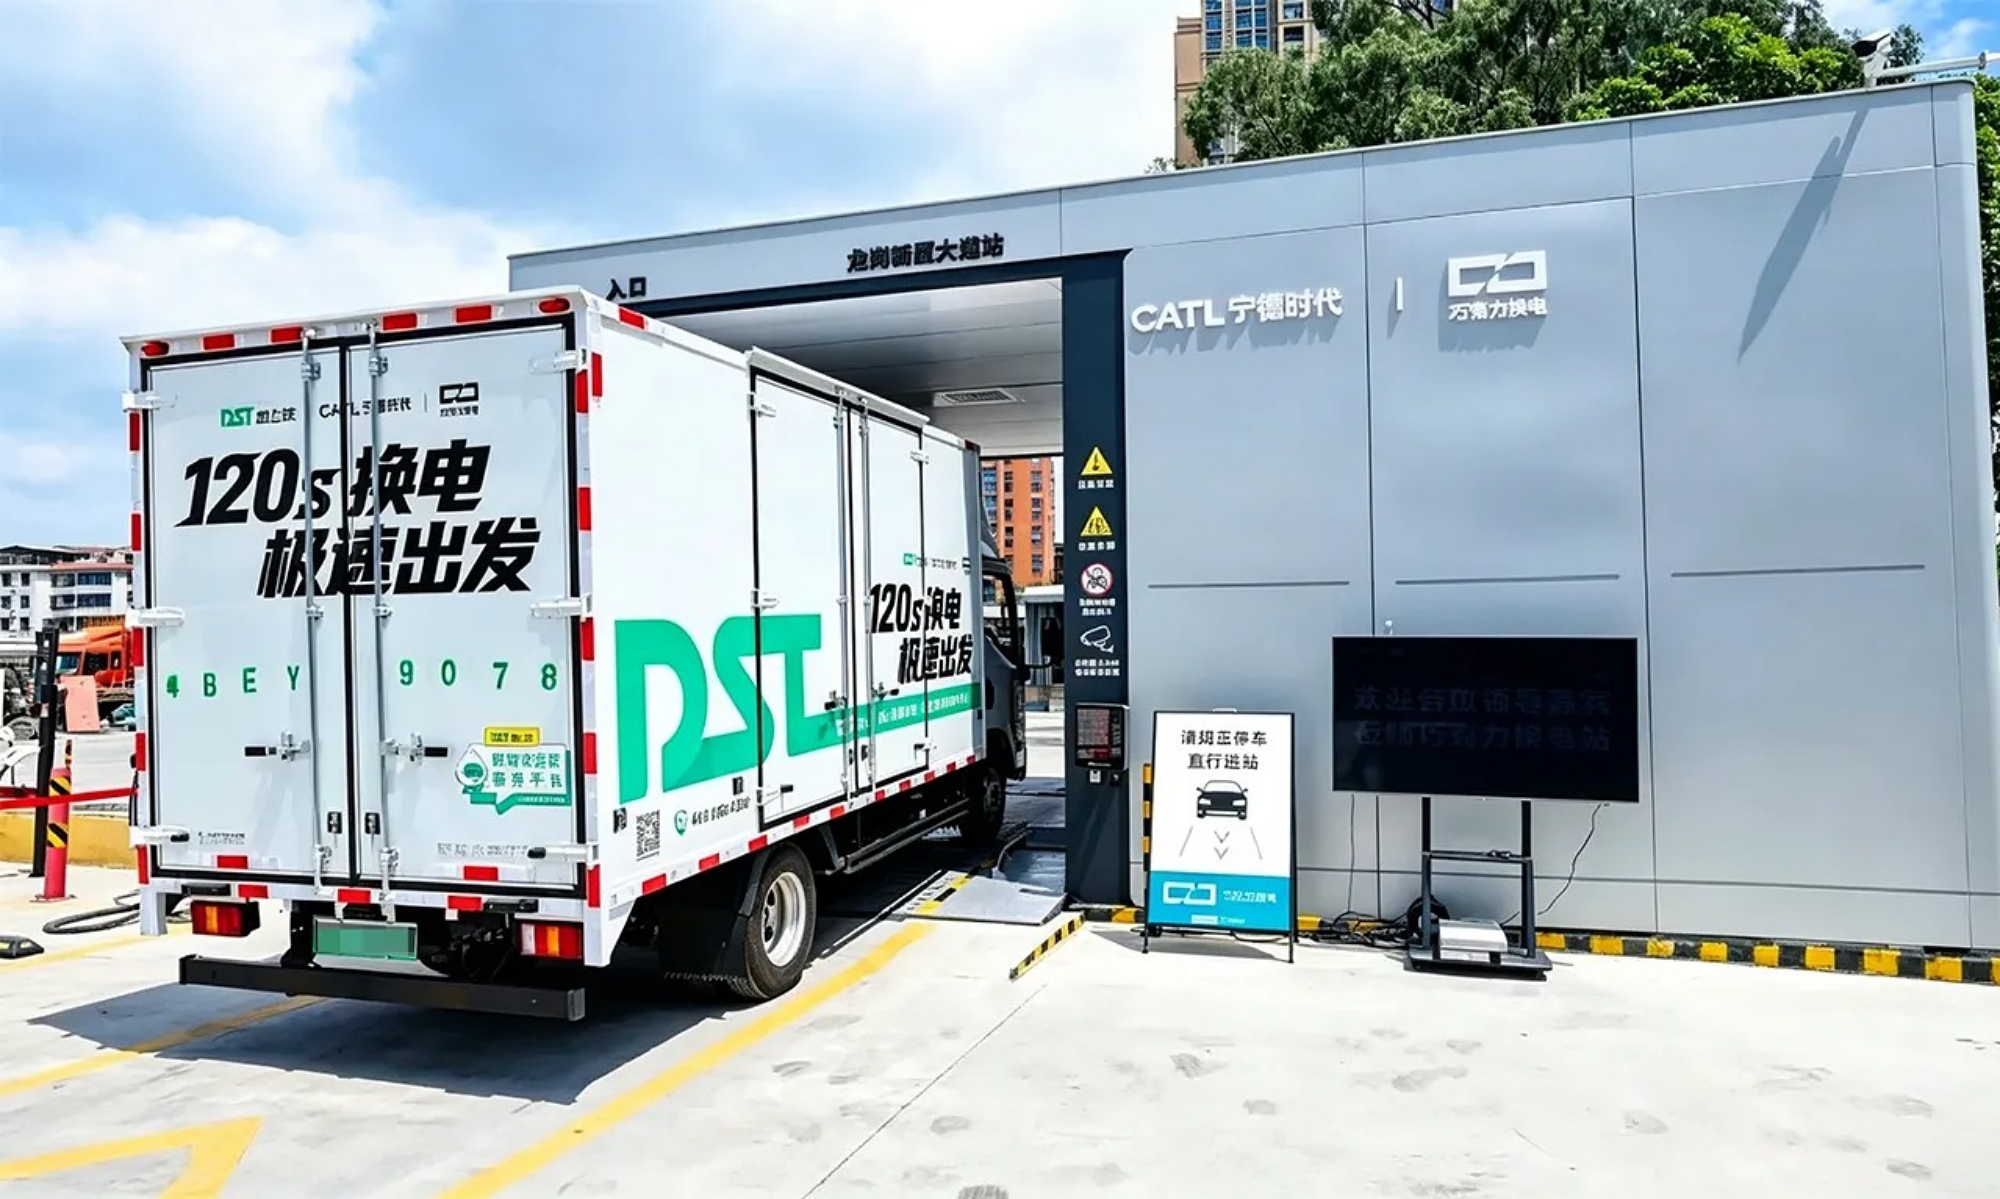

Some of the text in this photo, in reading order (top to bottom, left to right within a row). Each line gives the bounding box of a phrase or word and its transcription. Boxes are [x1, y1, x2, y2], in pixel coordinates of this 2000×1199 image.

[607, 275, 648, 301] 入口
[1130, 297, 1225, 332] CATL
[257, 516, 541, 598] 极速出发
[614, 613, 822, 805] DST
